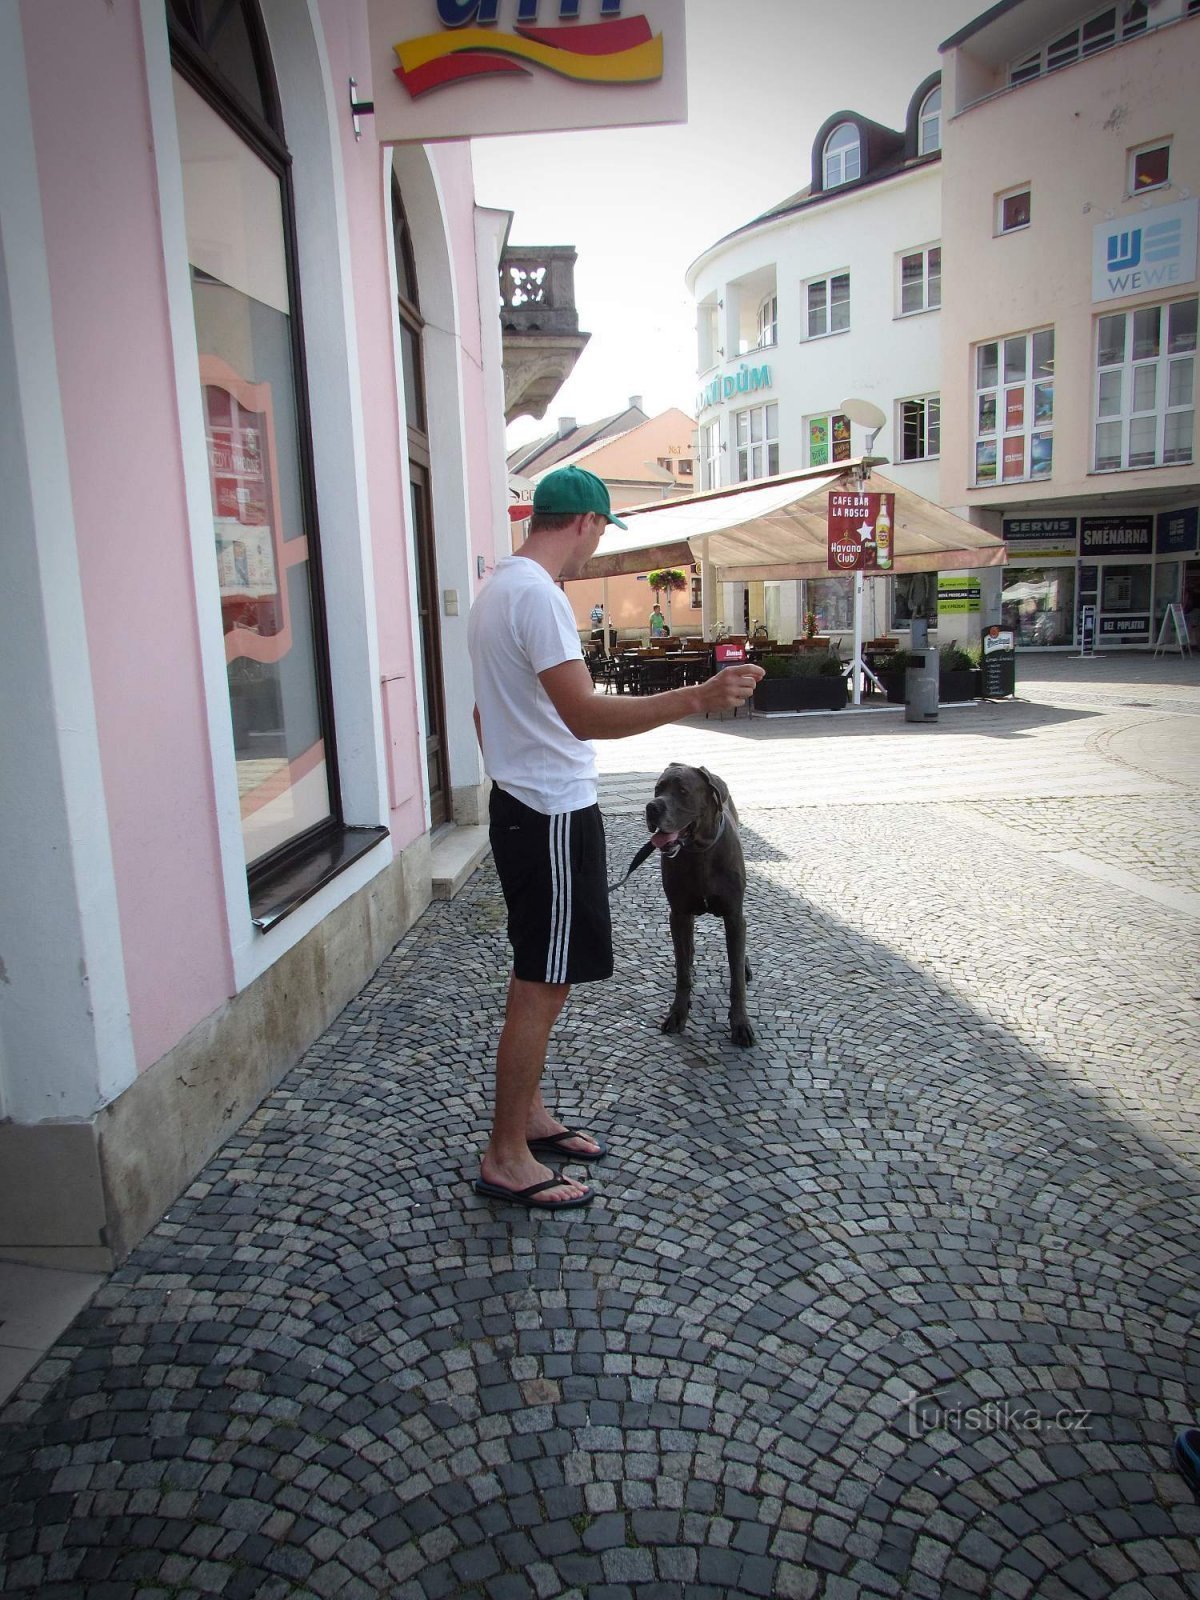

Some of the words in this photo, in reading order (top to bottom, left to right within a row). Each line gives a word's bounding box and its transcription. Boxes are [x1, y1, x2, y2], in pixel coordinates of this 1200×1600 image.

[1108, 262, 1180, 293] WEWE
[724, 363, 770, 398] DŮM
[833, 496, 851, 505] CAFE
[854, 497, 868, 506] BAR
[833, 508, 842, 516] LA
[844, 508, 869, 517] ROSCO
[1010, 521, 1070, 532] SERVIS
[1084, 526, 1148, 545] SMĚNÁRNA
[831, 542, 861, 552] Havana
[837, 553, 855, 563] Club
[1104, 621, 1114, 630] BEZ
[1117, 620, 1145, 630] POPLATKU
